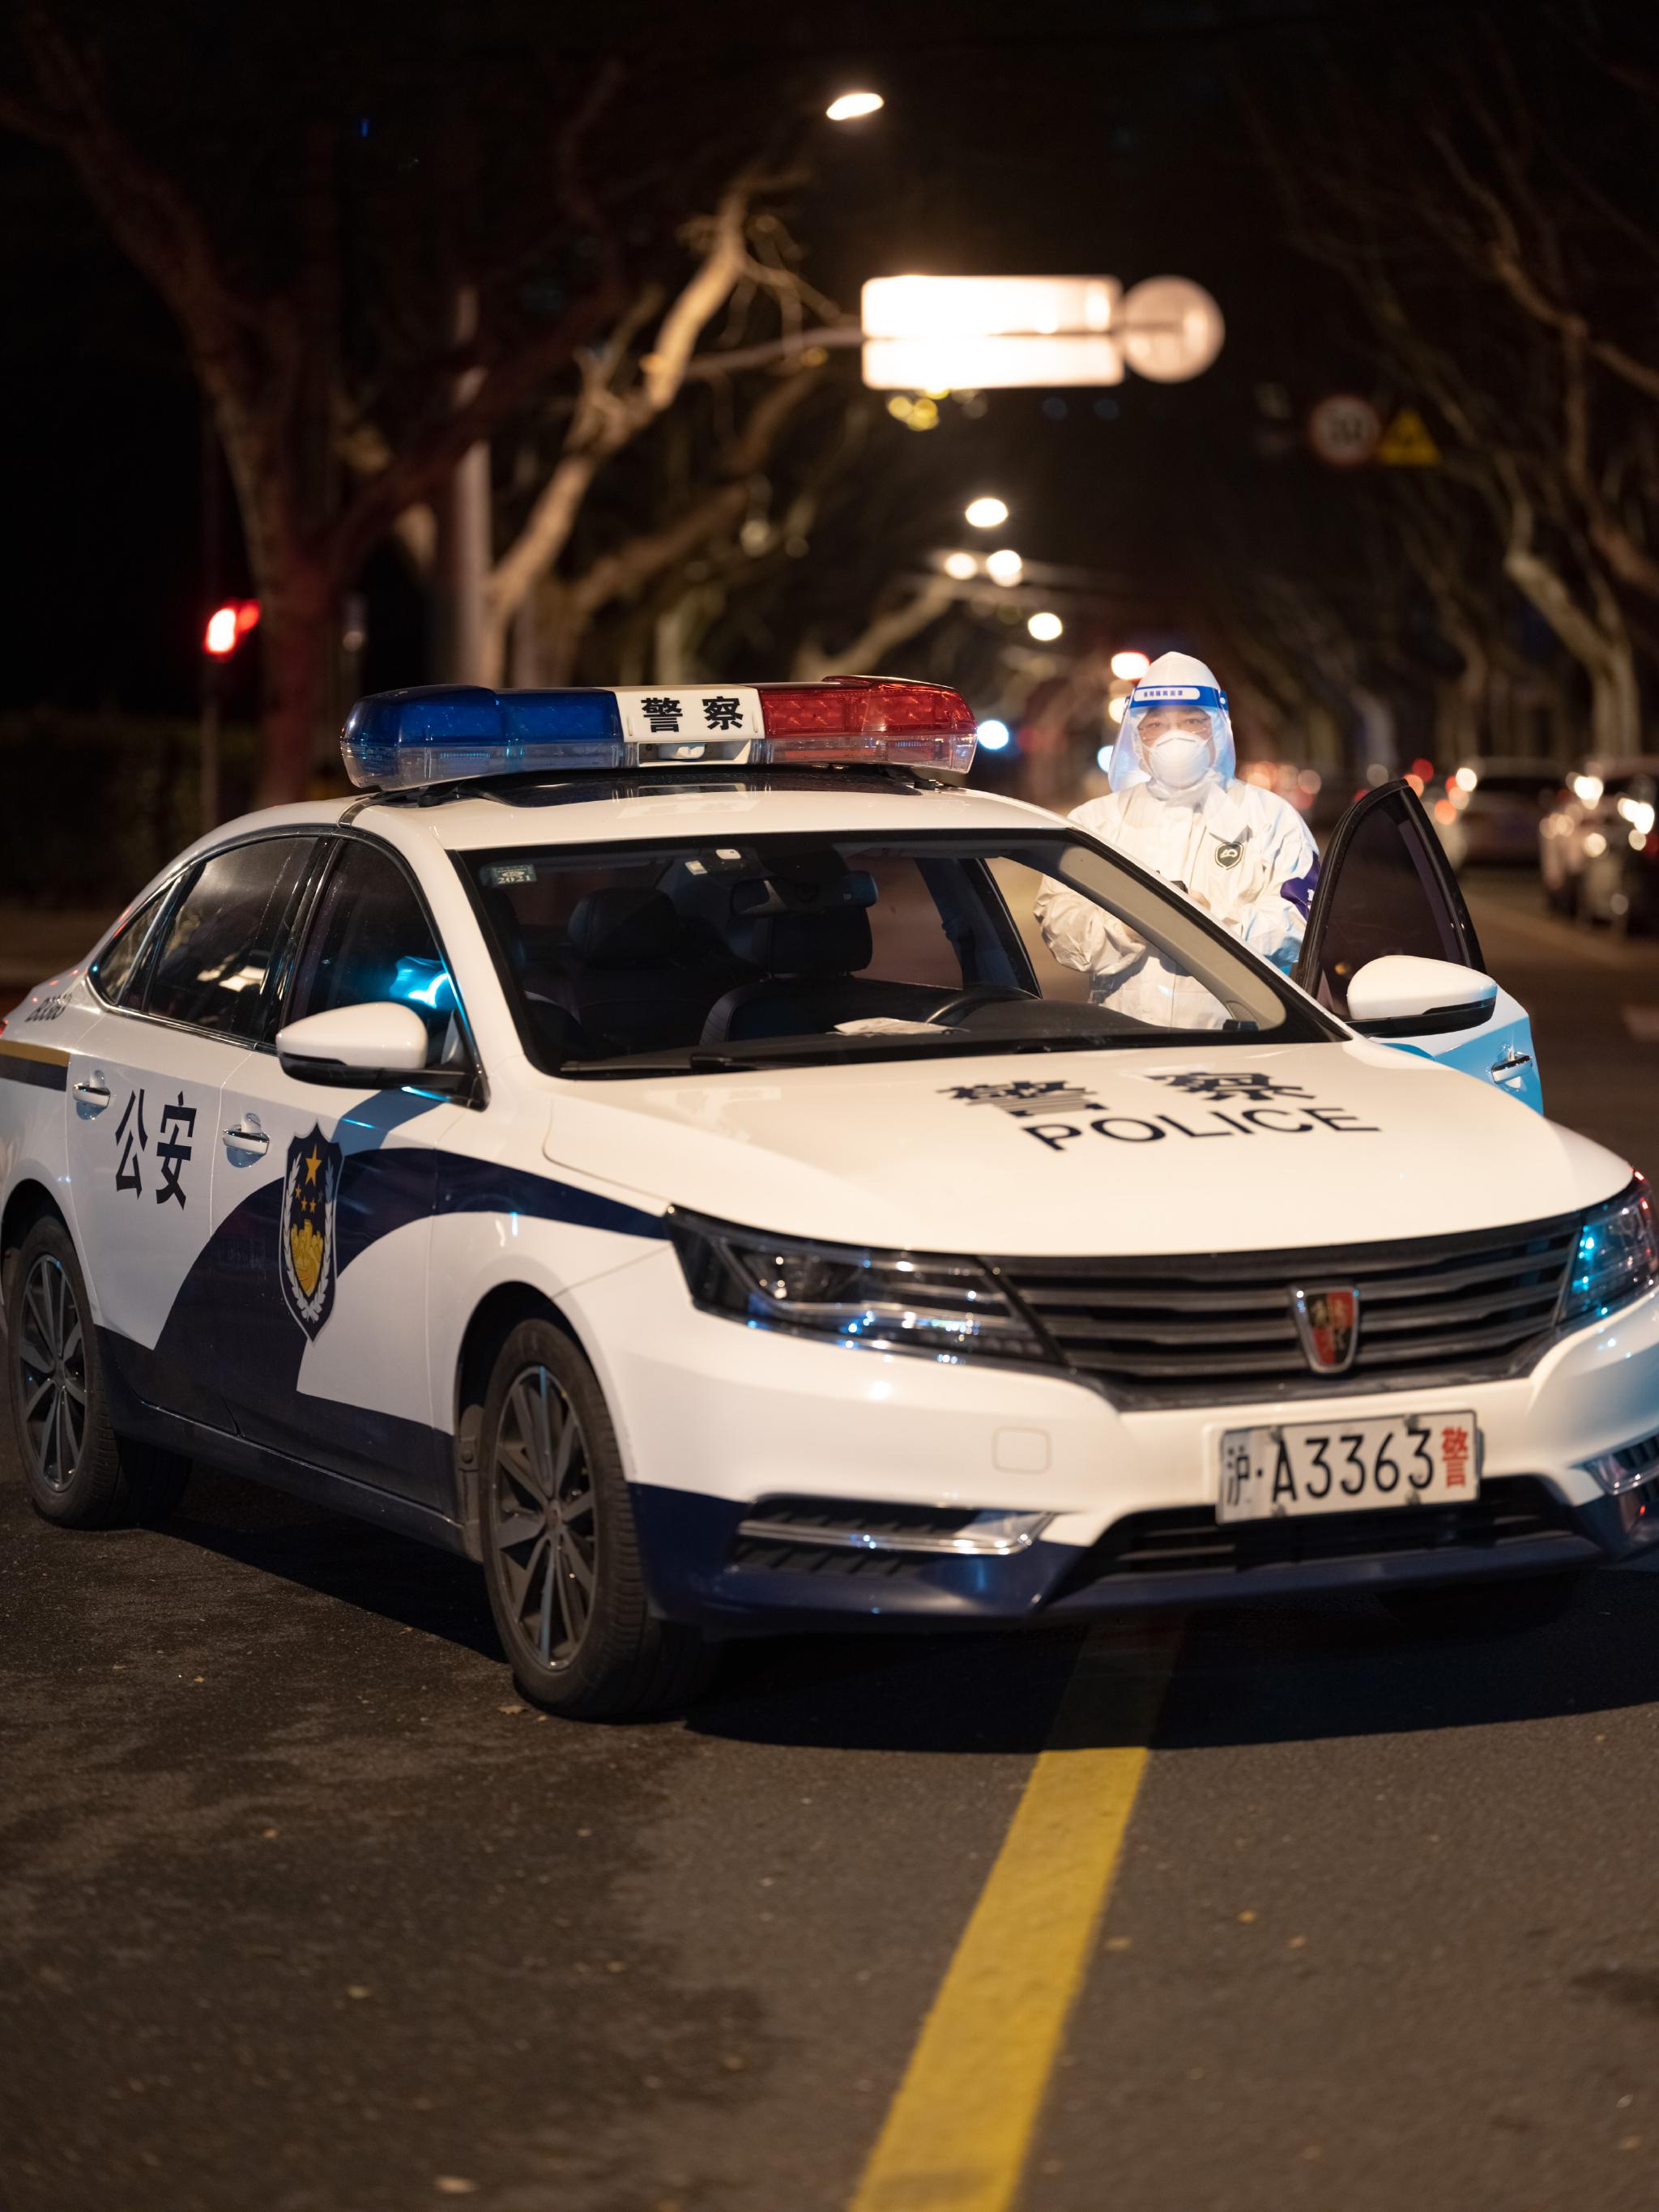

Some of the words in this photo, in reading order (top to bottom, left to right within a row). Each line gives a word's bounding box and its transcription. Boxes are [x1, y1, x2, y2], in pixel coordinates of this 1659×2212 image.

[641, 696, 744, 732] 警察
[497, 875, 532, 884] 2021
[936, 1071, 1317, 1118] 警察
[115, 1089, 197, 1210] 公安
[1020, 1106, 1382, 1151] POLICE
